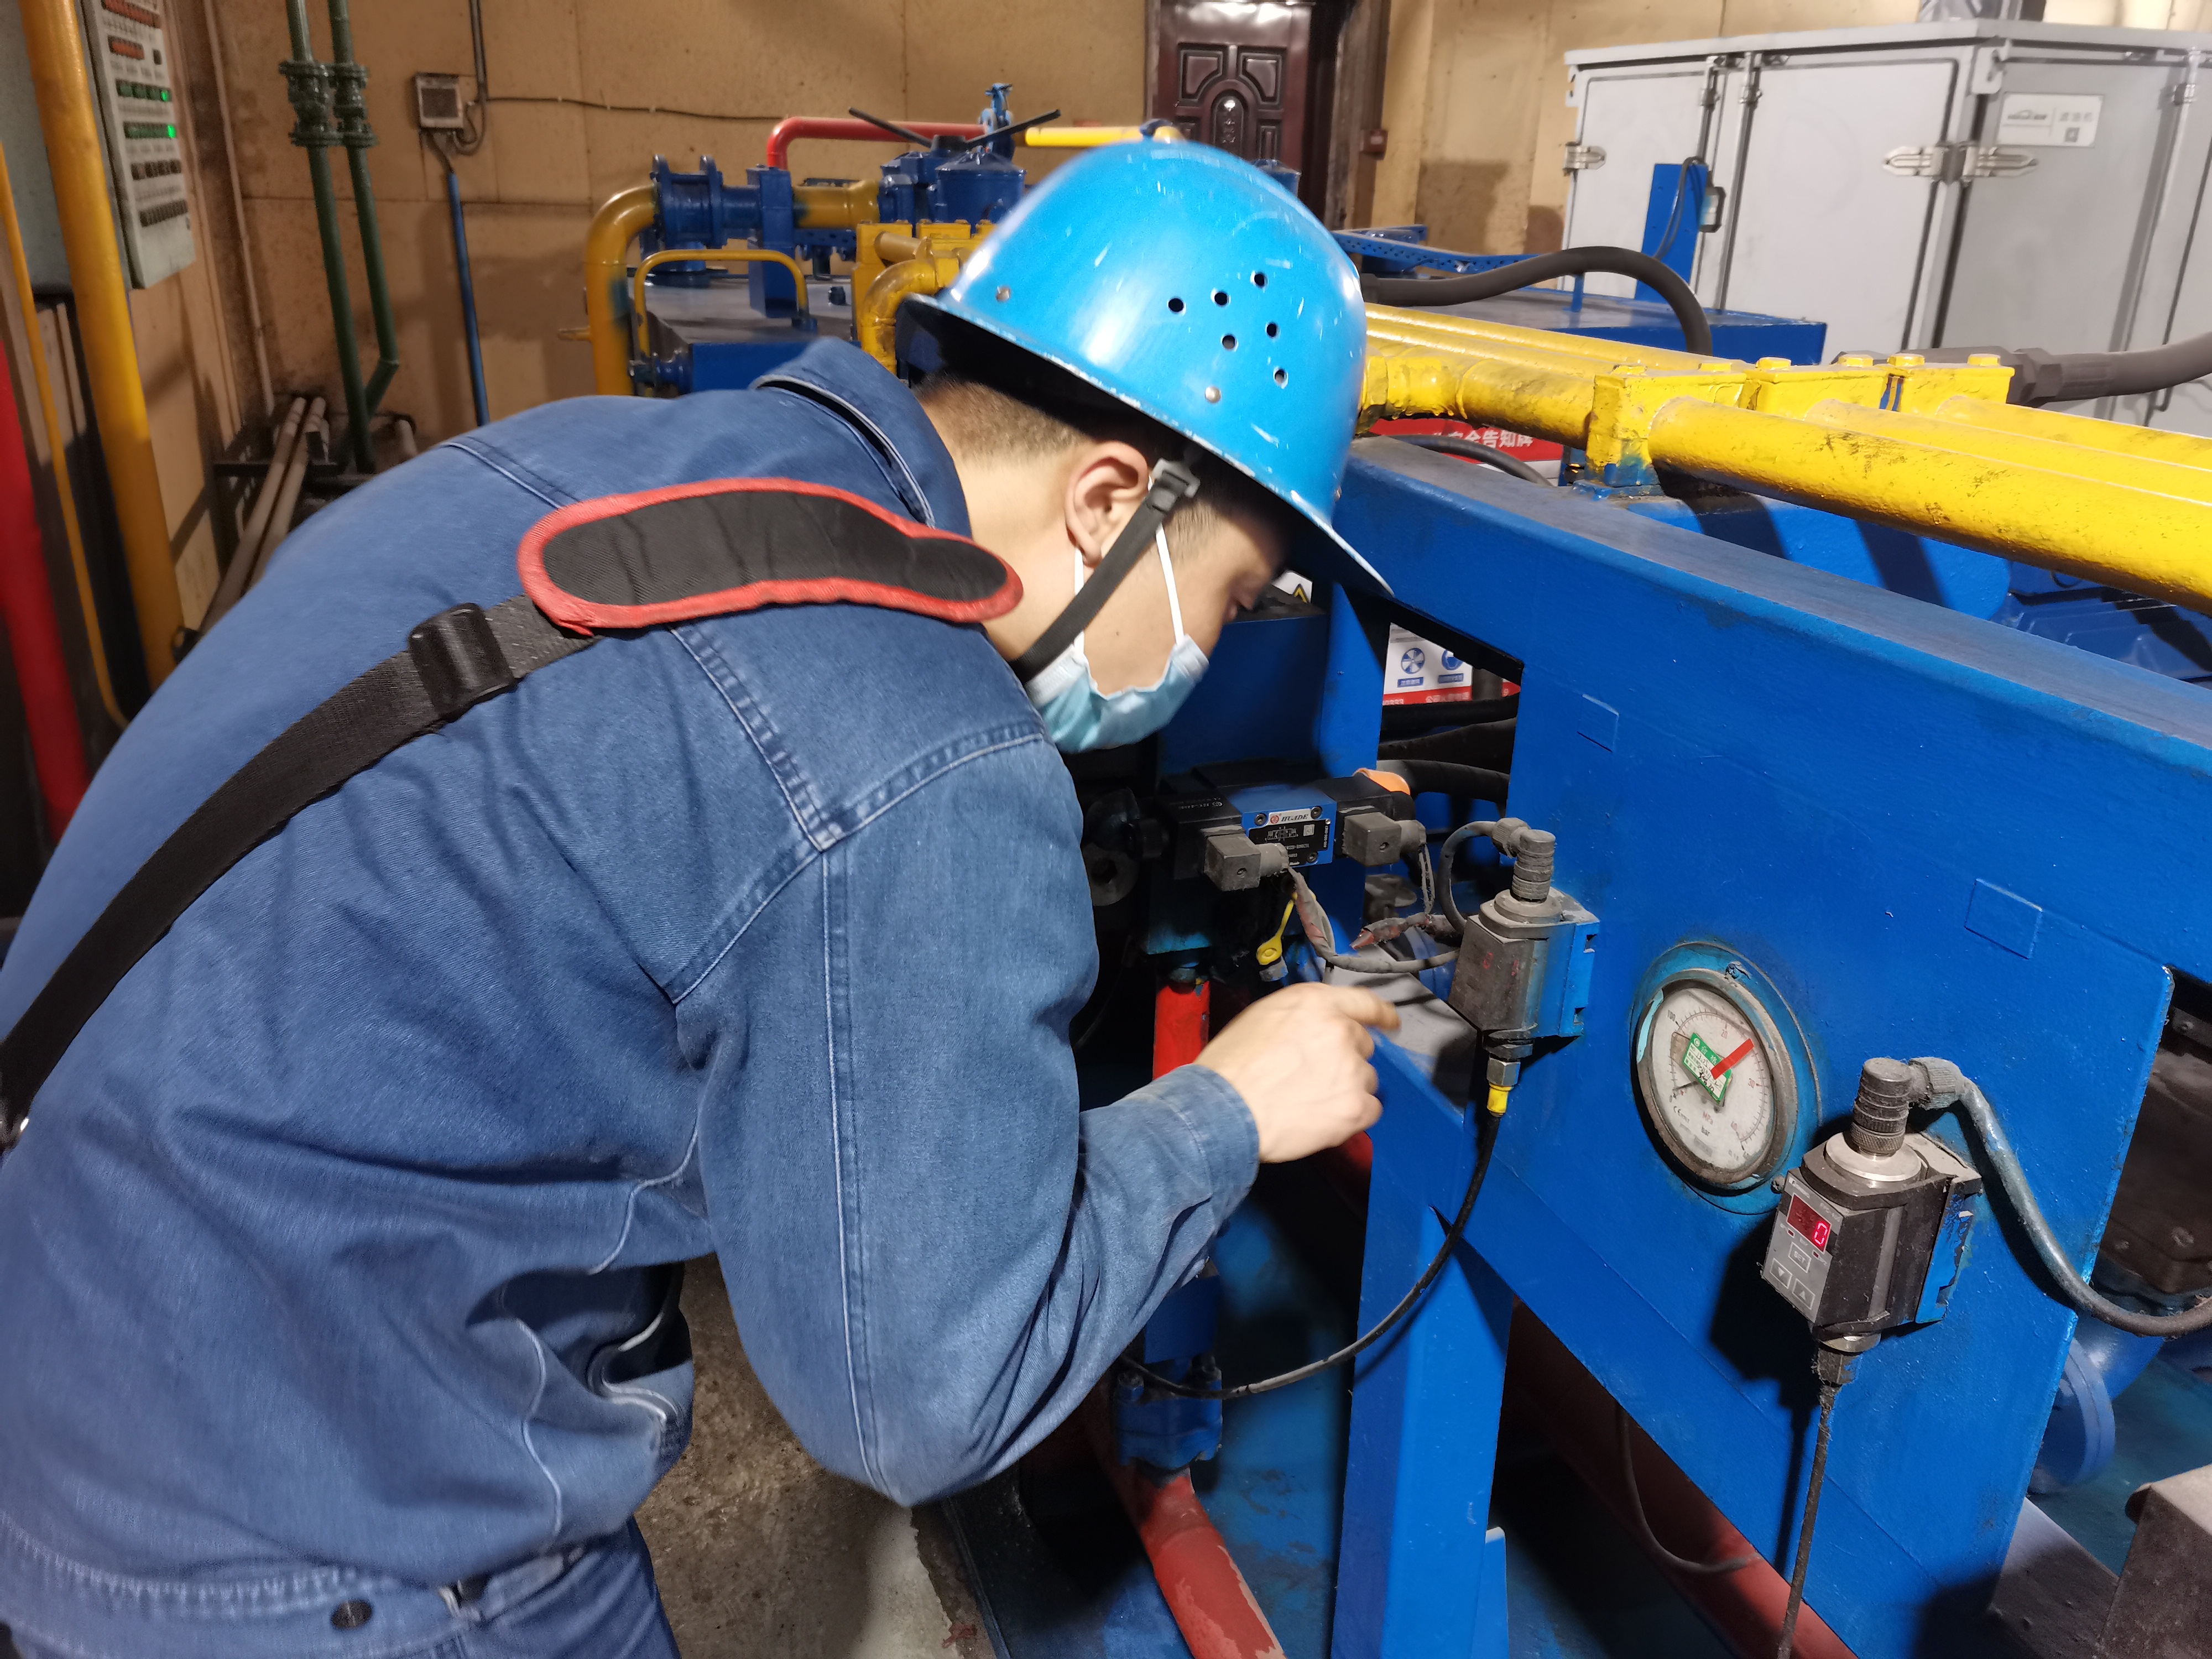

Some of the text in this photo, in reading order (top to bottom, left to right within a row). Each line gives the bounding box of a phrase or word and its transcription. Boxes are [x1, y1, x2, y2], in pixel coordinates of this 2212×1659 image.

[1433, 429, 1533, 448] 全告知牌
[1721, 1029, 1728, 1039] 20
[1748, 1078, 1756, 1088] 30
[1703, 1111, 1713, 1125] MPa
[1701, 1125, 1710, 1137] bar
[1813, 1222, 1828, 1245] 0
[1793, 1250, 1806, 1264] SET
